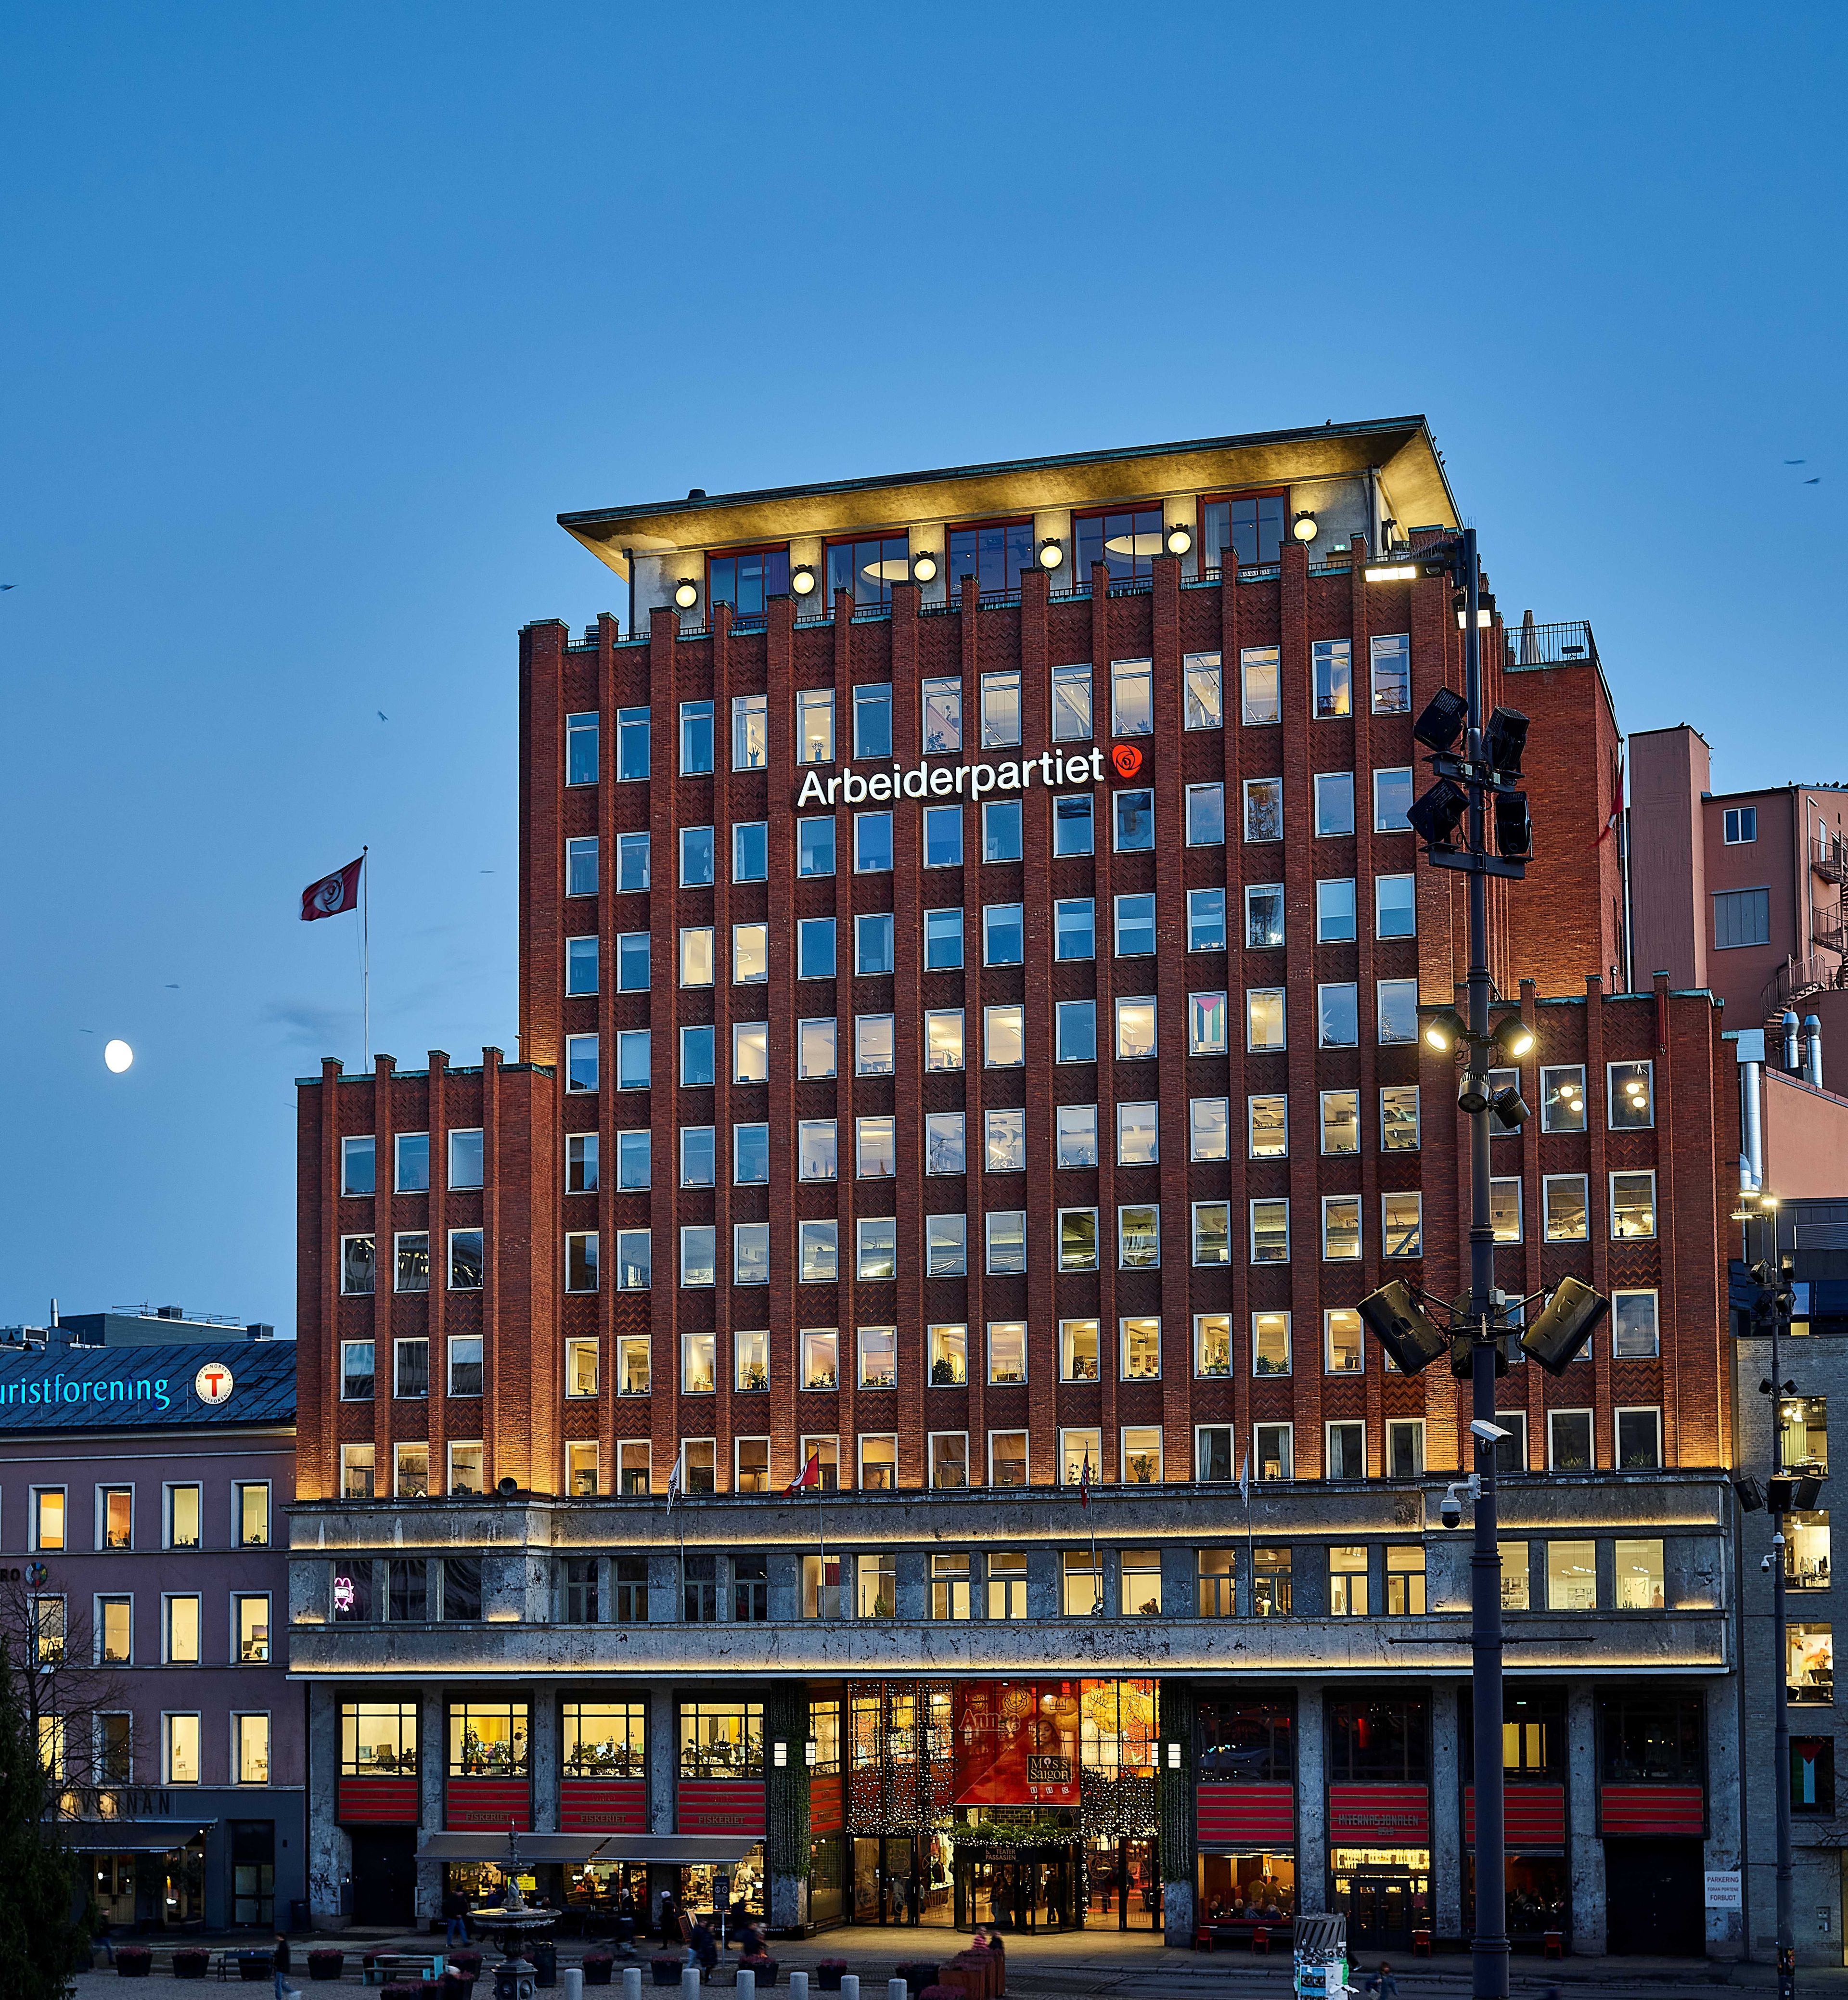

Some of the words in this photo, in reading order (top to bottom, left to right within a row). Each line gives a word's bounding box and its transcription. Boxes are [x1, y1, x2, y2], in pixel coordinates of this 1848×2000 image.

[797, 747, 1104, 808] Arbeiderpartiet
[198, 1367, 207, 1378] DEN
[210, 1364, 230, 1376] NORSKE
[205, 1373, 224, 1397] T
[197, 1384, 232, 1403] TURISTFORENING
[958, 1709, 1021, 1731] Annie
[1030, 1768, 1069, 1782] Saigon
[465, 1813, 511, 1821] FISKERIET
[1338, 1814, 1419, 1826] INTERNASJONALEN
